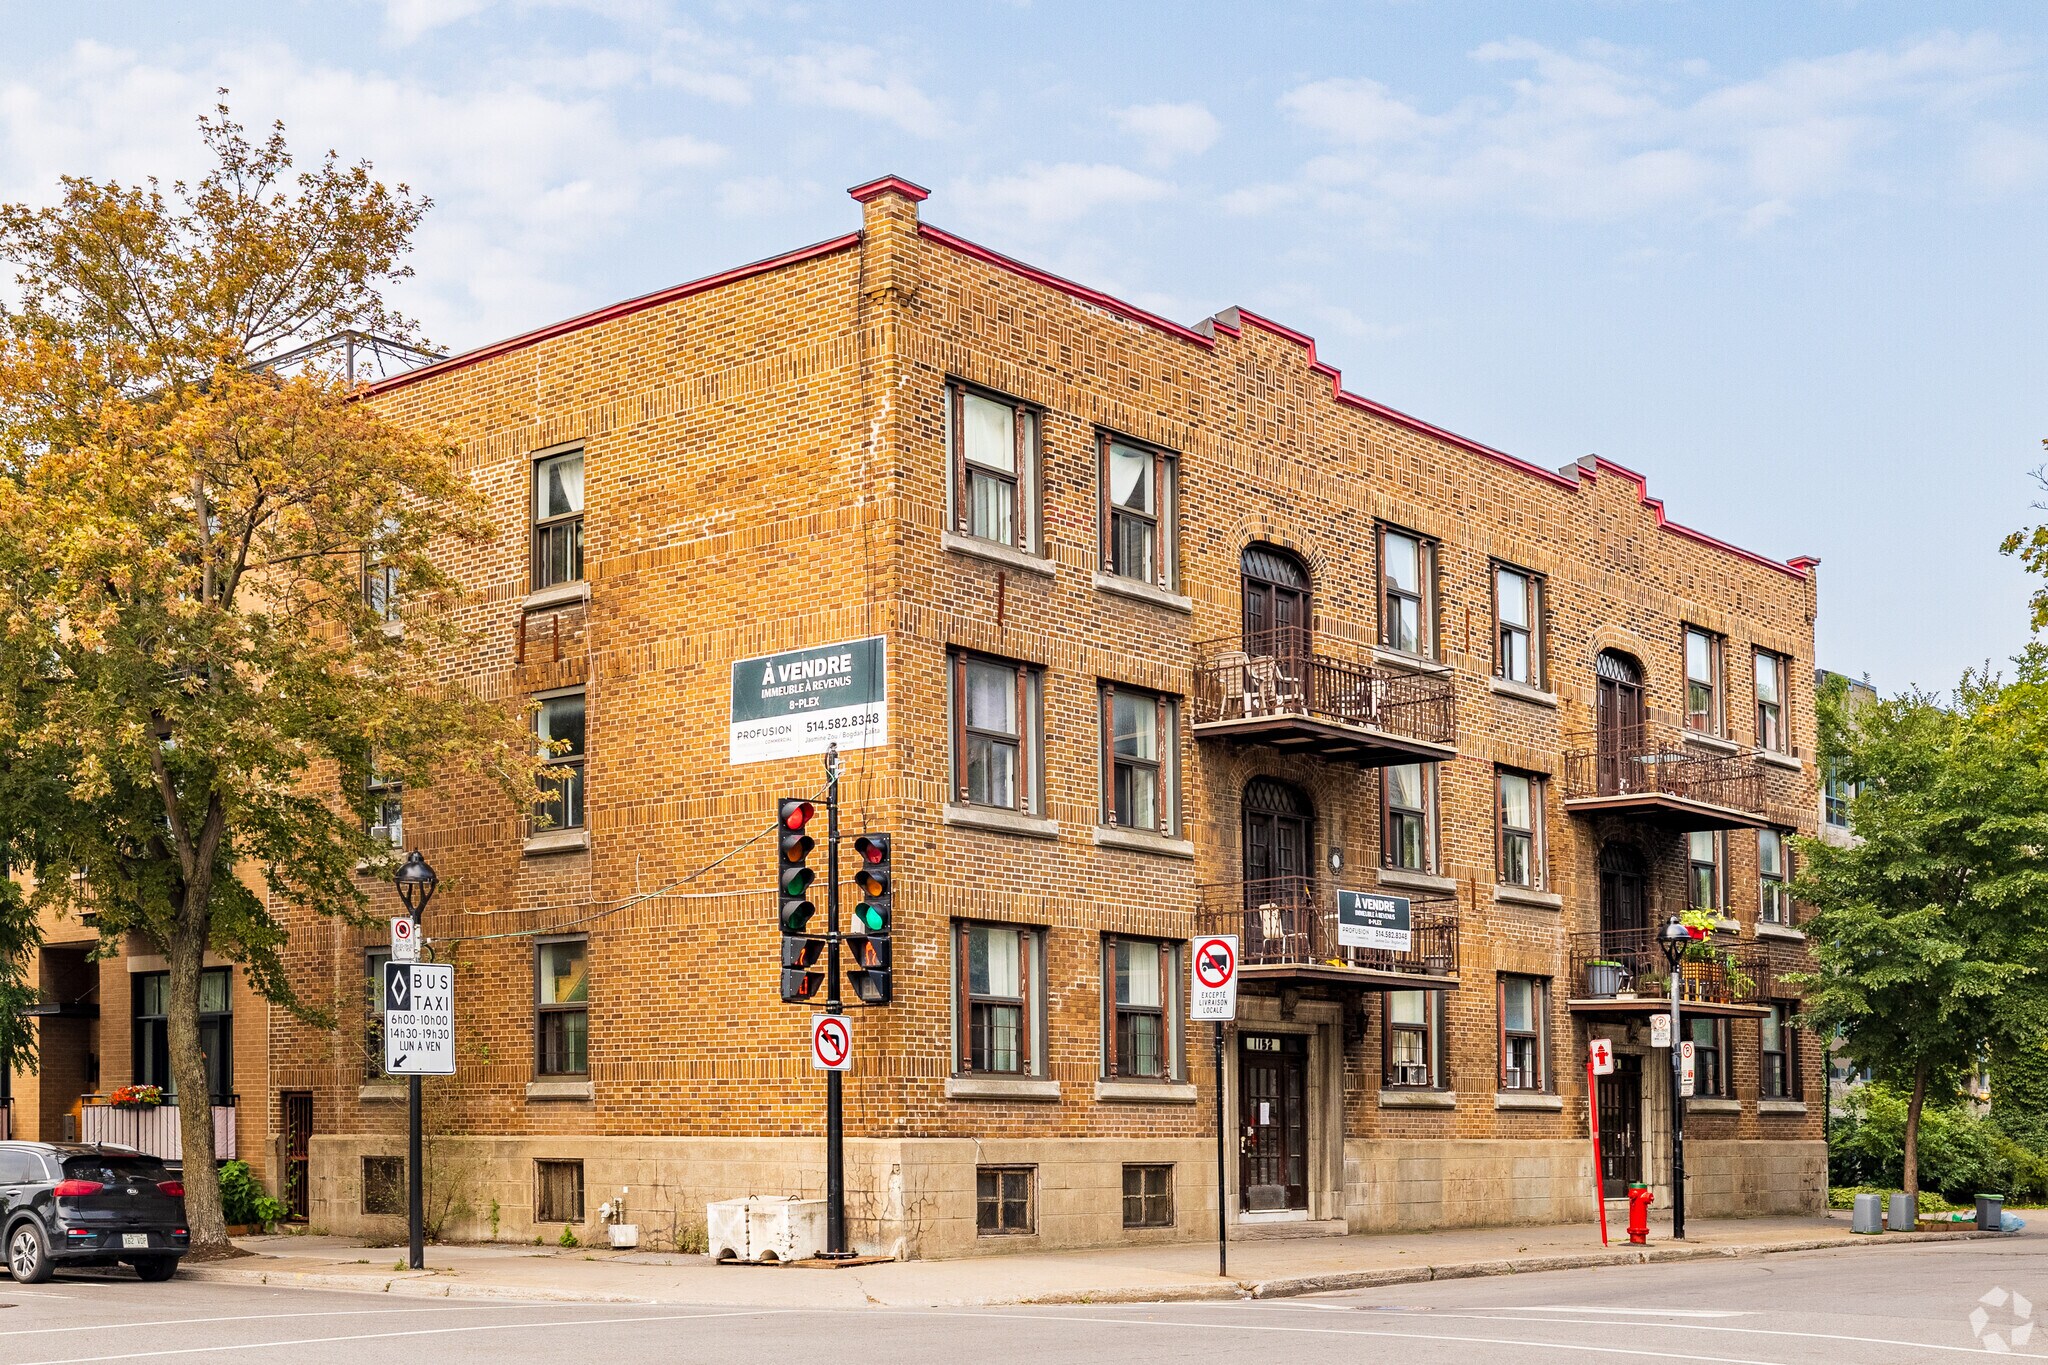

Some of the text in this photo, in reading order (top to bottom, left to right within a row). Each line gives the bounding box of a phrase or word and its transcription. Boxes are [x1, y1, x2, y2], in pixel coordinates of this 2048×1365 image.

[762, 653, 851, 685] À VENDRE
[761, 675, 851, 699] IMMEUBLE À REVENUS
[789, 696, 819, 710] 8-PLEX
[806, 713, 879, 733] 514.582.8348
[737, 725, 792, 741] PROFUSION
[1355, 894, 1395, 912] À VENDRE
[1342, 926, 1369, 935] PROFUSION
[1376, 930, 1407, 940] 514.582.8348
[414, 974, 448, 990] BUS
[414, 996, 448, 1011] TAXI
[390, 1028, 449, 1040] 14h30-19h30
[400, 1041, 414, 1051] LUN
[426, 1041, 441, 1051] VEN
[1254, 1038, 1273, 1050] 1152
